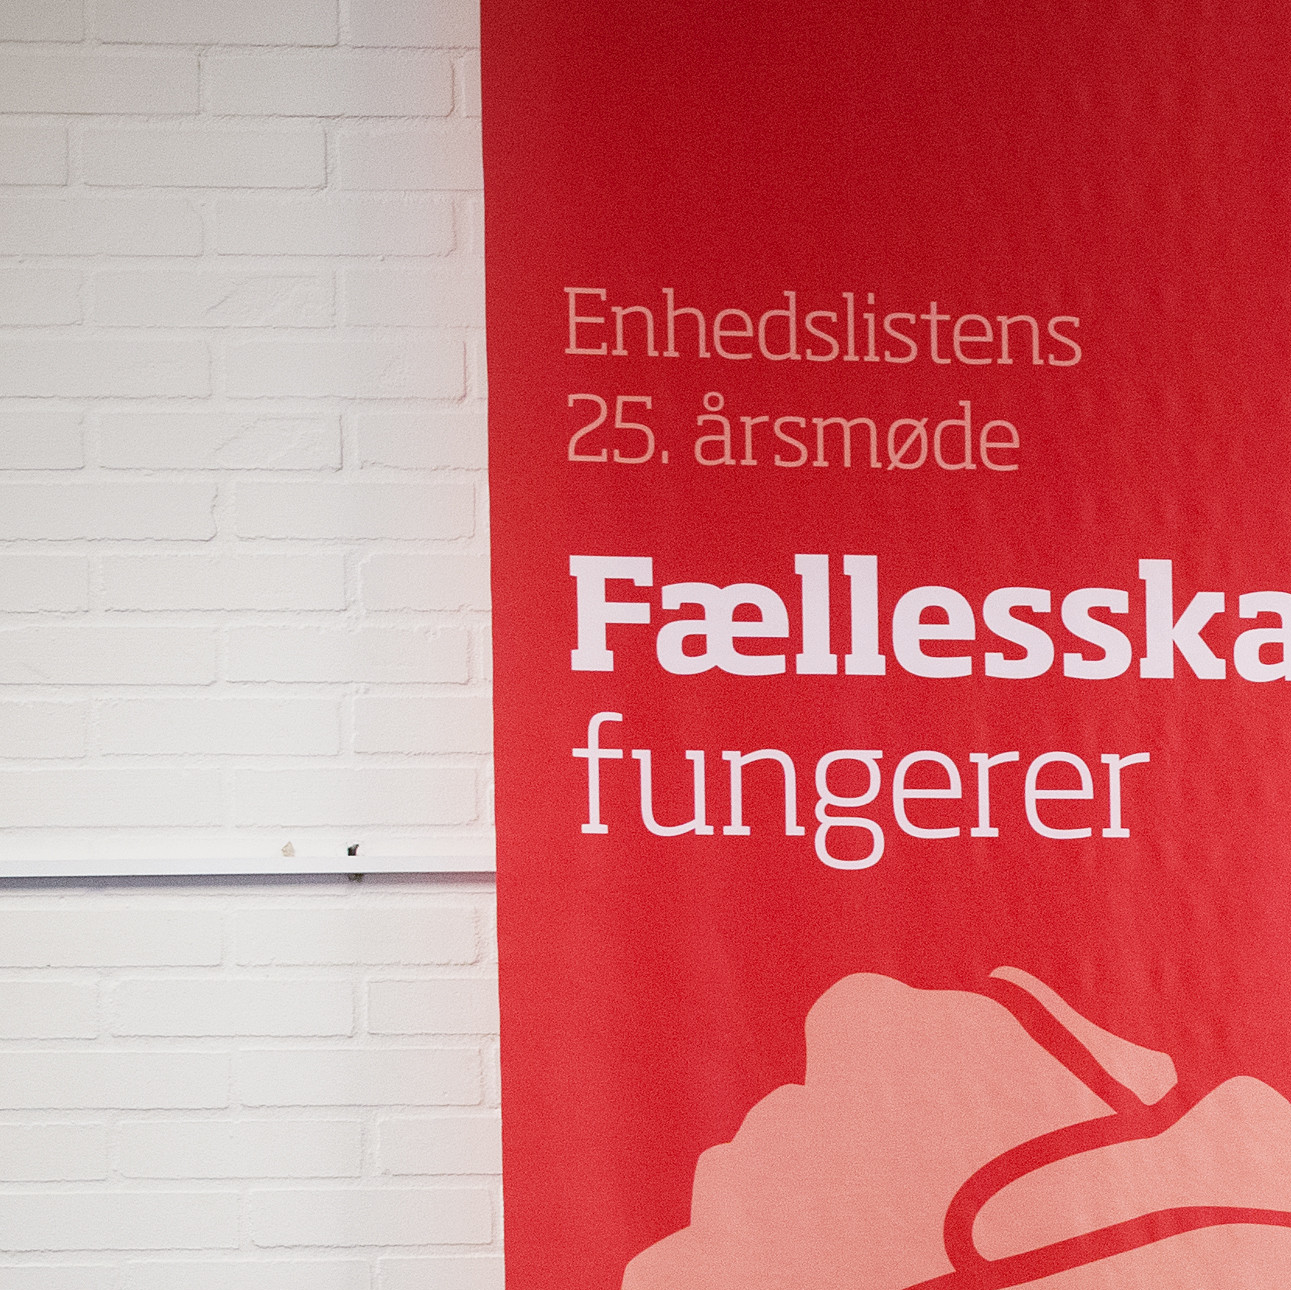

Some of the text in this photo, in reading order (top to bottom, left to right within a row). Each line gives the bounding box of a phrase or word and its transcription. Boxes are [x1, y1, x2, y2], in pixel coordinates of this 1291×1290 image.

[563, 286, 1083, 368] Enhedslistens
[566, 392, 1021, 472] 25. årsmøde
[571, 711, 1150, 871] fungerer
